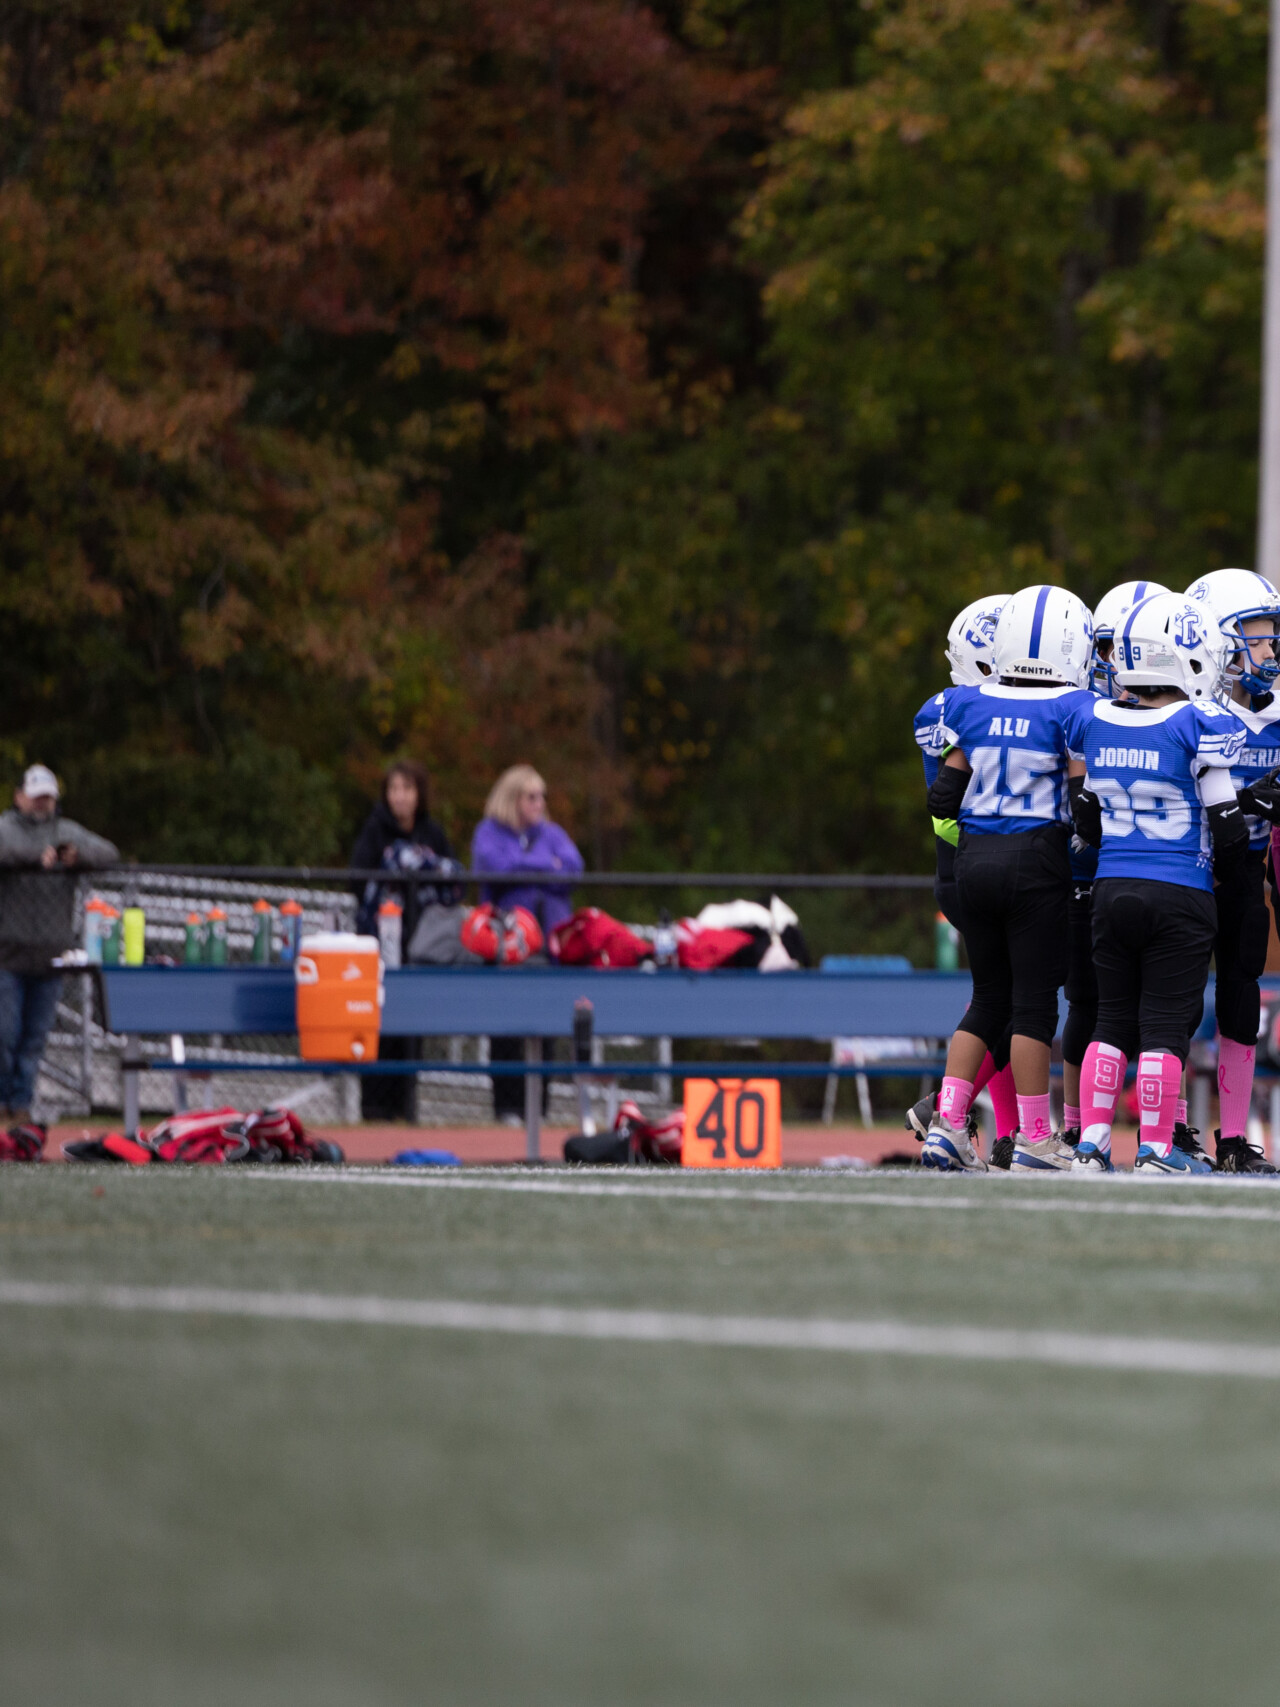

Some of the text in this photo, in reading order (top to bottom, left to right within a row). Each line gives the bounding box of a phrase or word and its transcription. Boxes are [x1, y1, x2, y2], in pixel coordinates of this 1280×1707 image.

[1132, 646, 1142, 661] 9
[1013, 664, 1053, 676] XENITH
[988, 717, 1031, 738] ALU
[1094, 747, 1160, 771] JODOIN
[959, 746, 1061, 820] 45
[1089, 778, 1193, 840] 99
[1094, 1057, 1120, 1090] 9
[1140, 1077, 1162, 1108] 9
[695, 1087, 766, 1159] 40
